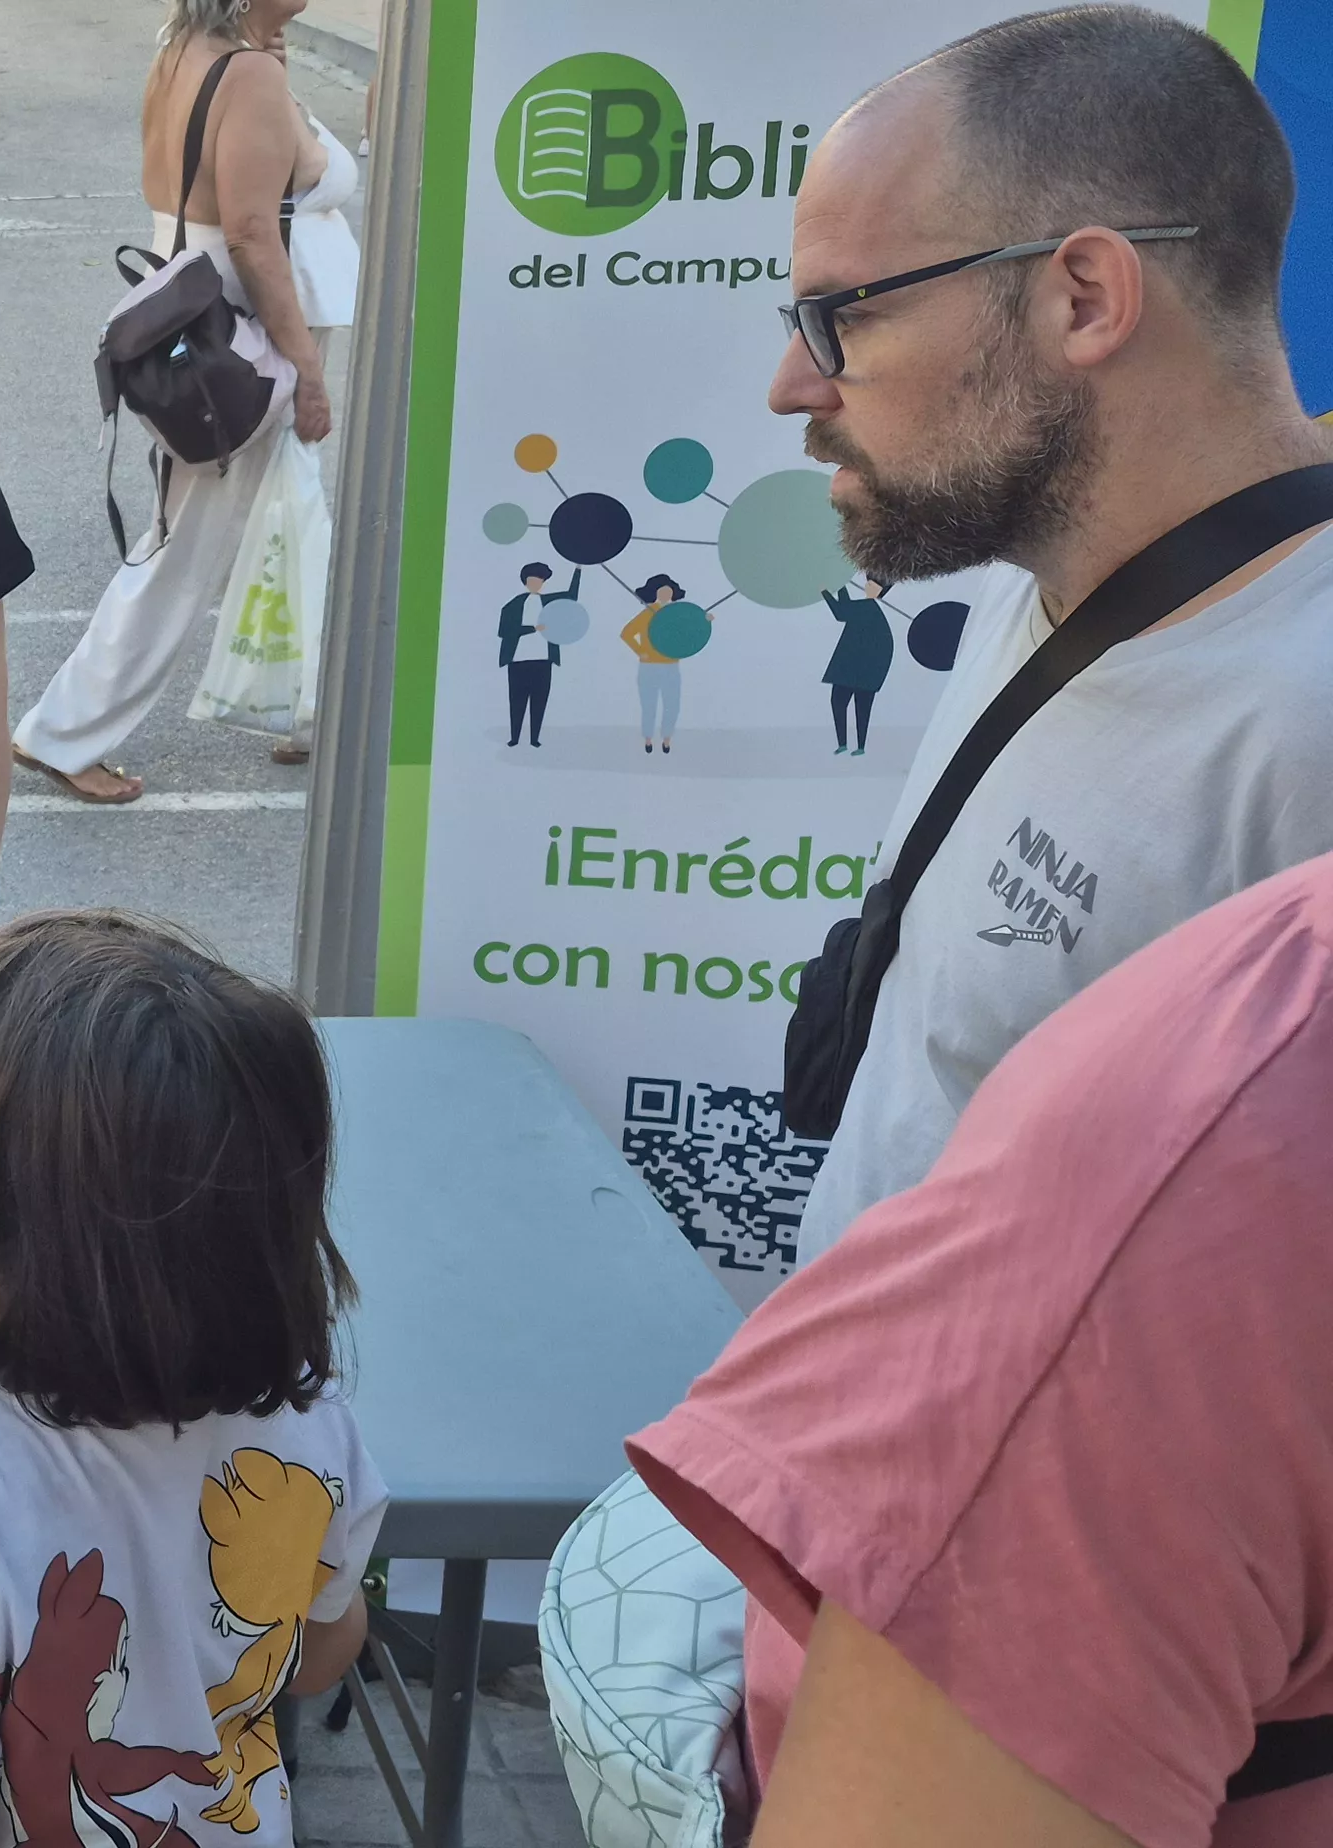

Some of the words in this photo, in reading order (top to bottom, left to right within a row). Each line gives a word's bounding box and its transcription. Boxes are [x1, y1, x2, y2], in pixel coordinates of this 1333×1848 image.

[585, 88, 810, 208] Bibli
[509, 253, 587, 289] del
[605, 251, 792, 289] Campu
[545, 825, 882, 900] ¡Enréda
[1006, 816, 1098, 915] NINJA
[473, 940, 610, 989] con
